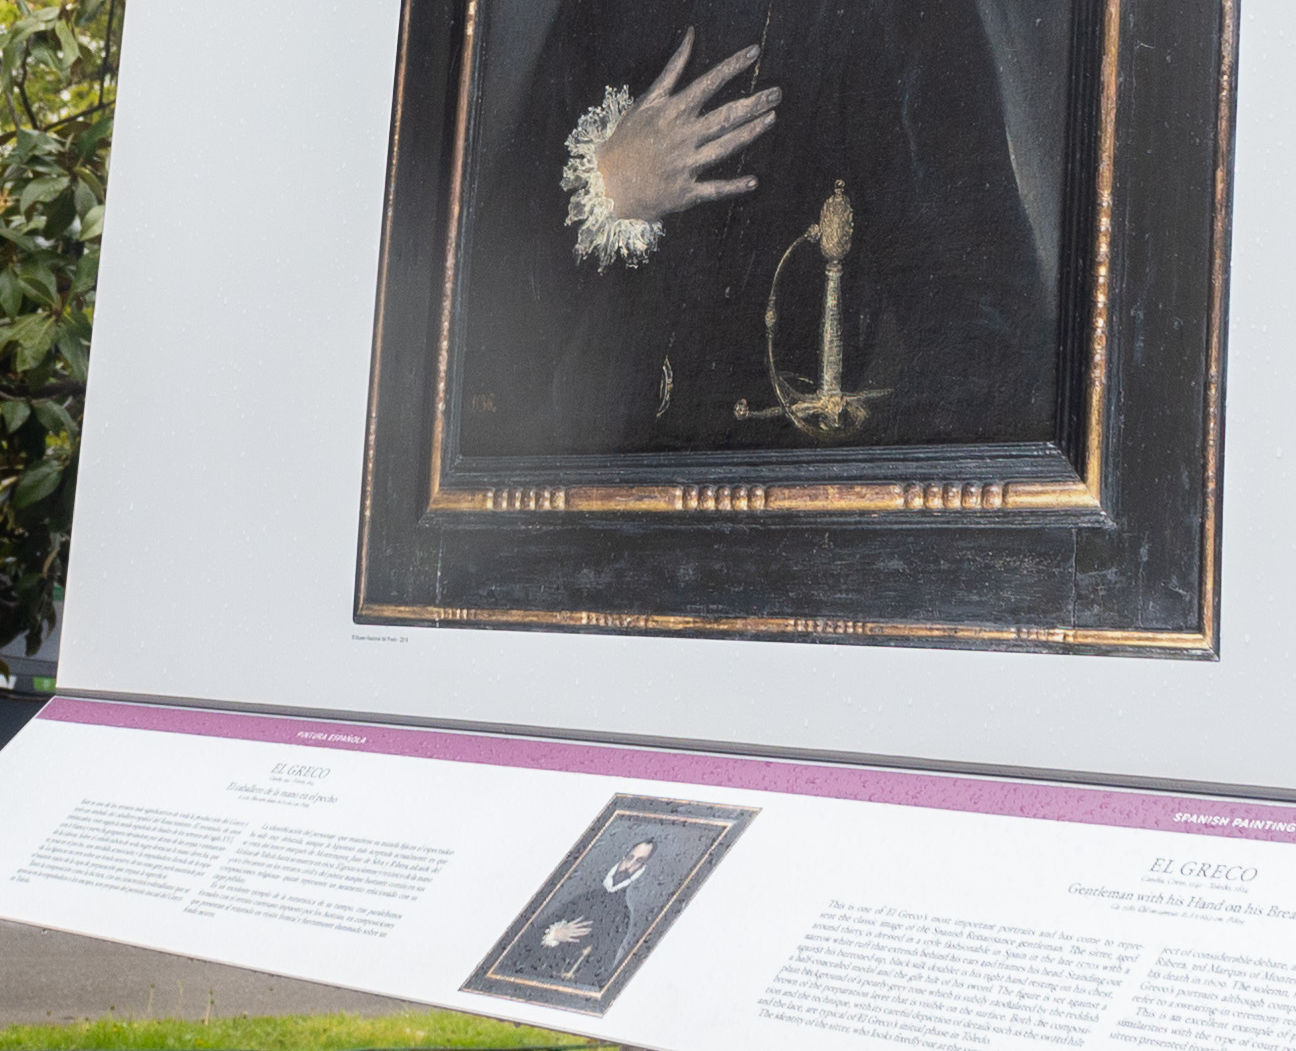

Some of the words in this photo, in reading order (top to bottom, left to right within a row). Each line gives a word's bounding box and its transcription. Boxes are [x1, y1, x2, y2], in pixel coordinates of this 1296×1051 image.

[296, 731, 328, 741] PINTURA
[327, 732, 367, 745] ESPAÑOLA
[271, 762, 286, 774] EL
[287, 764, 331, 779] GRECO
[1172, 812, 1231, 828] SPANISH
[1231, 816, 1296, 834] PAINTING
[1148, 857, 1175, 874] EL
[1179, 861, 1258, 882] GRECO
[1068, 881, 1134, 901] Gentleman
[1136, 891, 1164, 905] with
[1166, 894, 1185, 908] his
[1186, 895, 1226, 912] Hand
[1225, 903, 1242, 913] on
[1244, 902, 1264, 917] his
[1192, 951, 1252, 965] considerable
[1146, 968, 1161, 979] his
[1162, 971, 1190, 983] death
[1232, 980, 1251, 991] The
[1131, 994, 1155, 1004] refer
[1231, 1010, 1280, 1024] ceremony
[1174, 988, 1218, 1000] portraits
[1220, 993, 1265, 1009] although
[1135, 1006, 1155, 1017] This
[1169, 1014, 1182, 1022] an
[1184, 1017, 1229, 1029] excellent
[1231, 1024, 1273, 1037] example
[1109, 1031, 1141, 1042] sitters
[1137, 1036, 1189, 1050] presented
[1170, 1027, 1192, 1037] with
[1213, 1034, 1236, 1046] type
[1250, 1041, 1279, 1051] court
